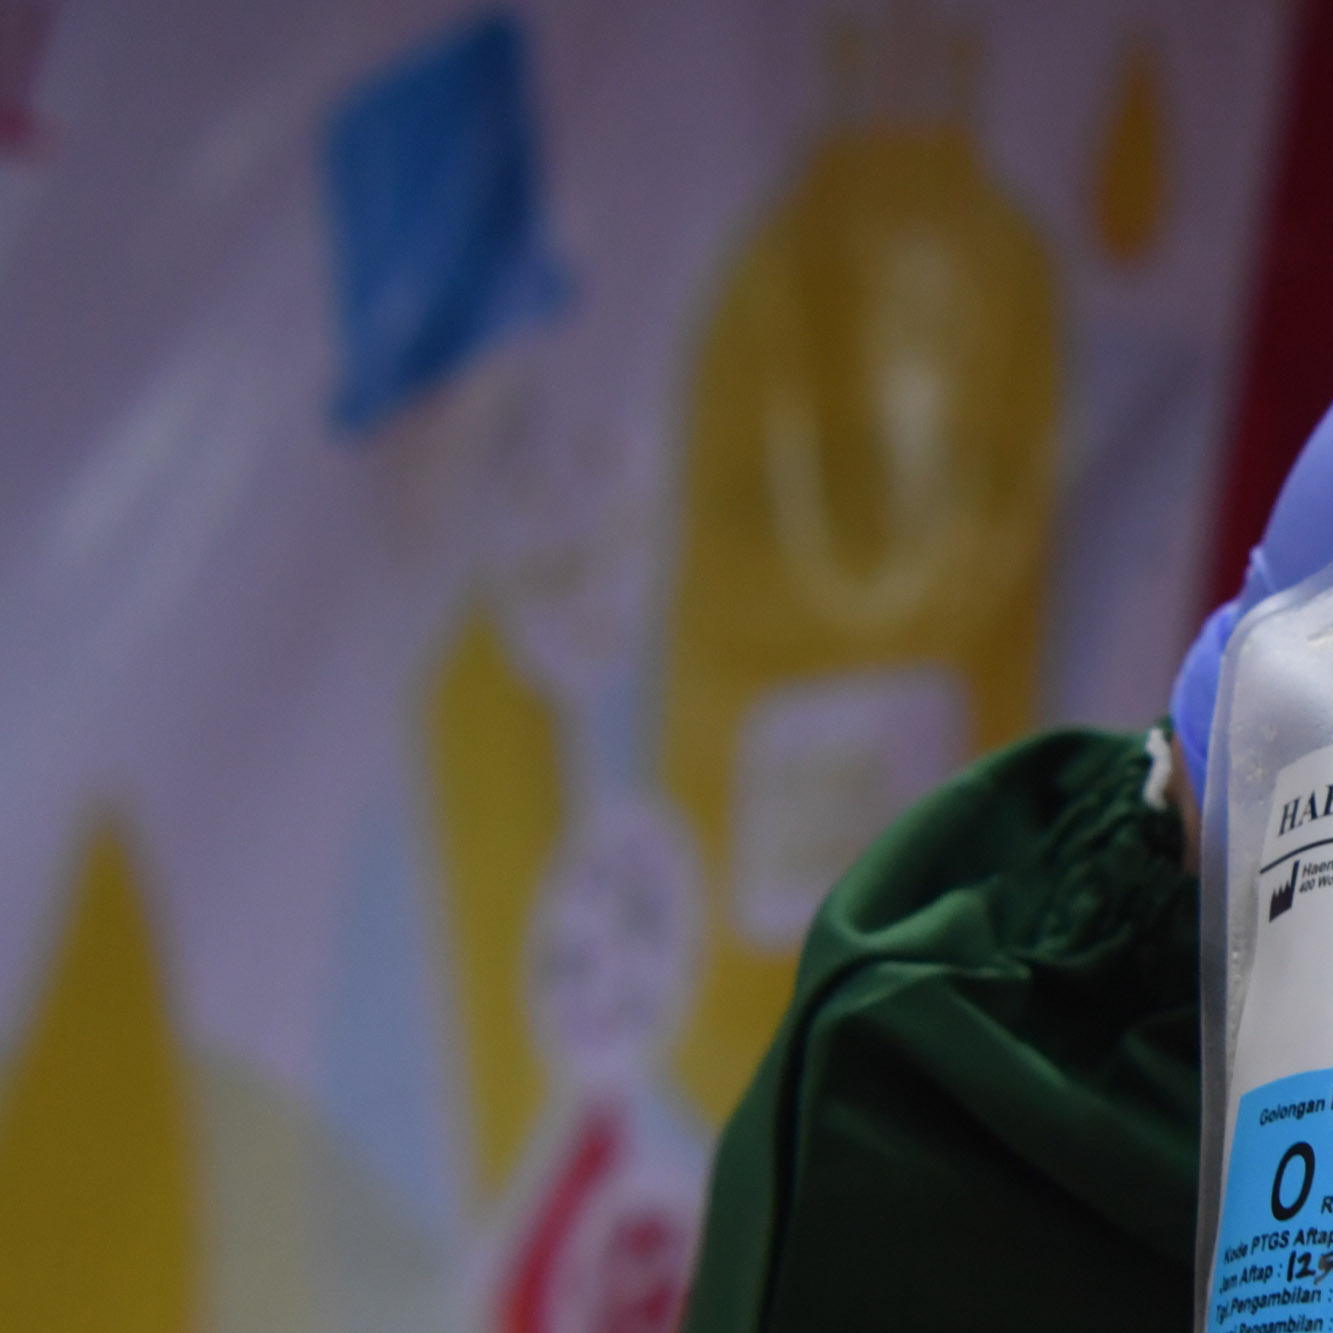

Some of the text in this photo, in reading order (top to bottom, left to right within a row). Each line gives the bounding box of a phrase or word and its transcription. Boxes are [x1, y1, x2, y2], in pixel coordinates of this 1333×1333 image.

[1299, 877, 1316, 894] 400
[1259, 1097, 1325, 1127] Golongan
[1223, 1241, 1249, 1265] Kode
[1251, 1229, 1290, 1256] PTGS
[1219, 1273, 1238, 1294] Jam
[1239, 1265, 1274, 1287] Aftap
